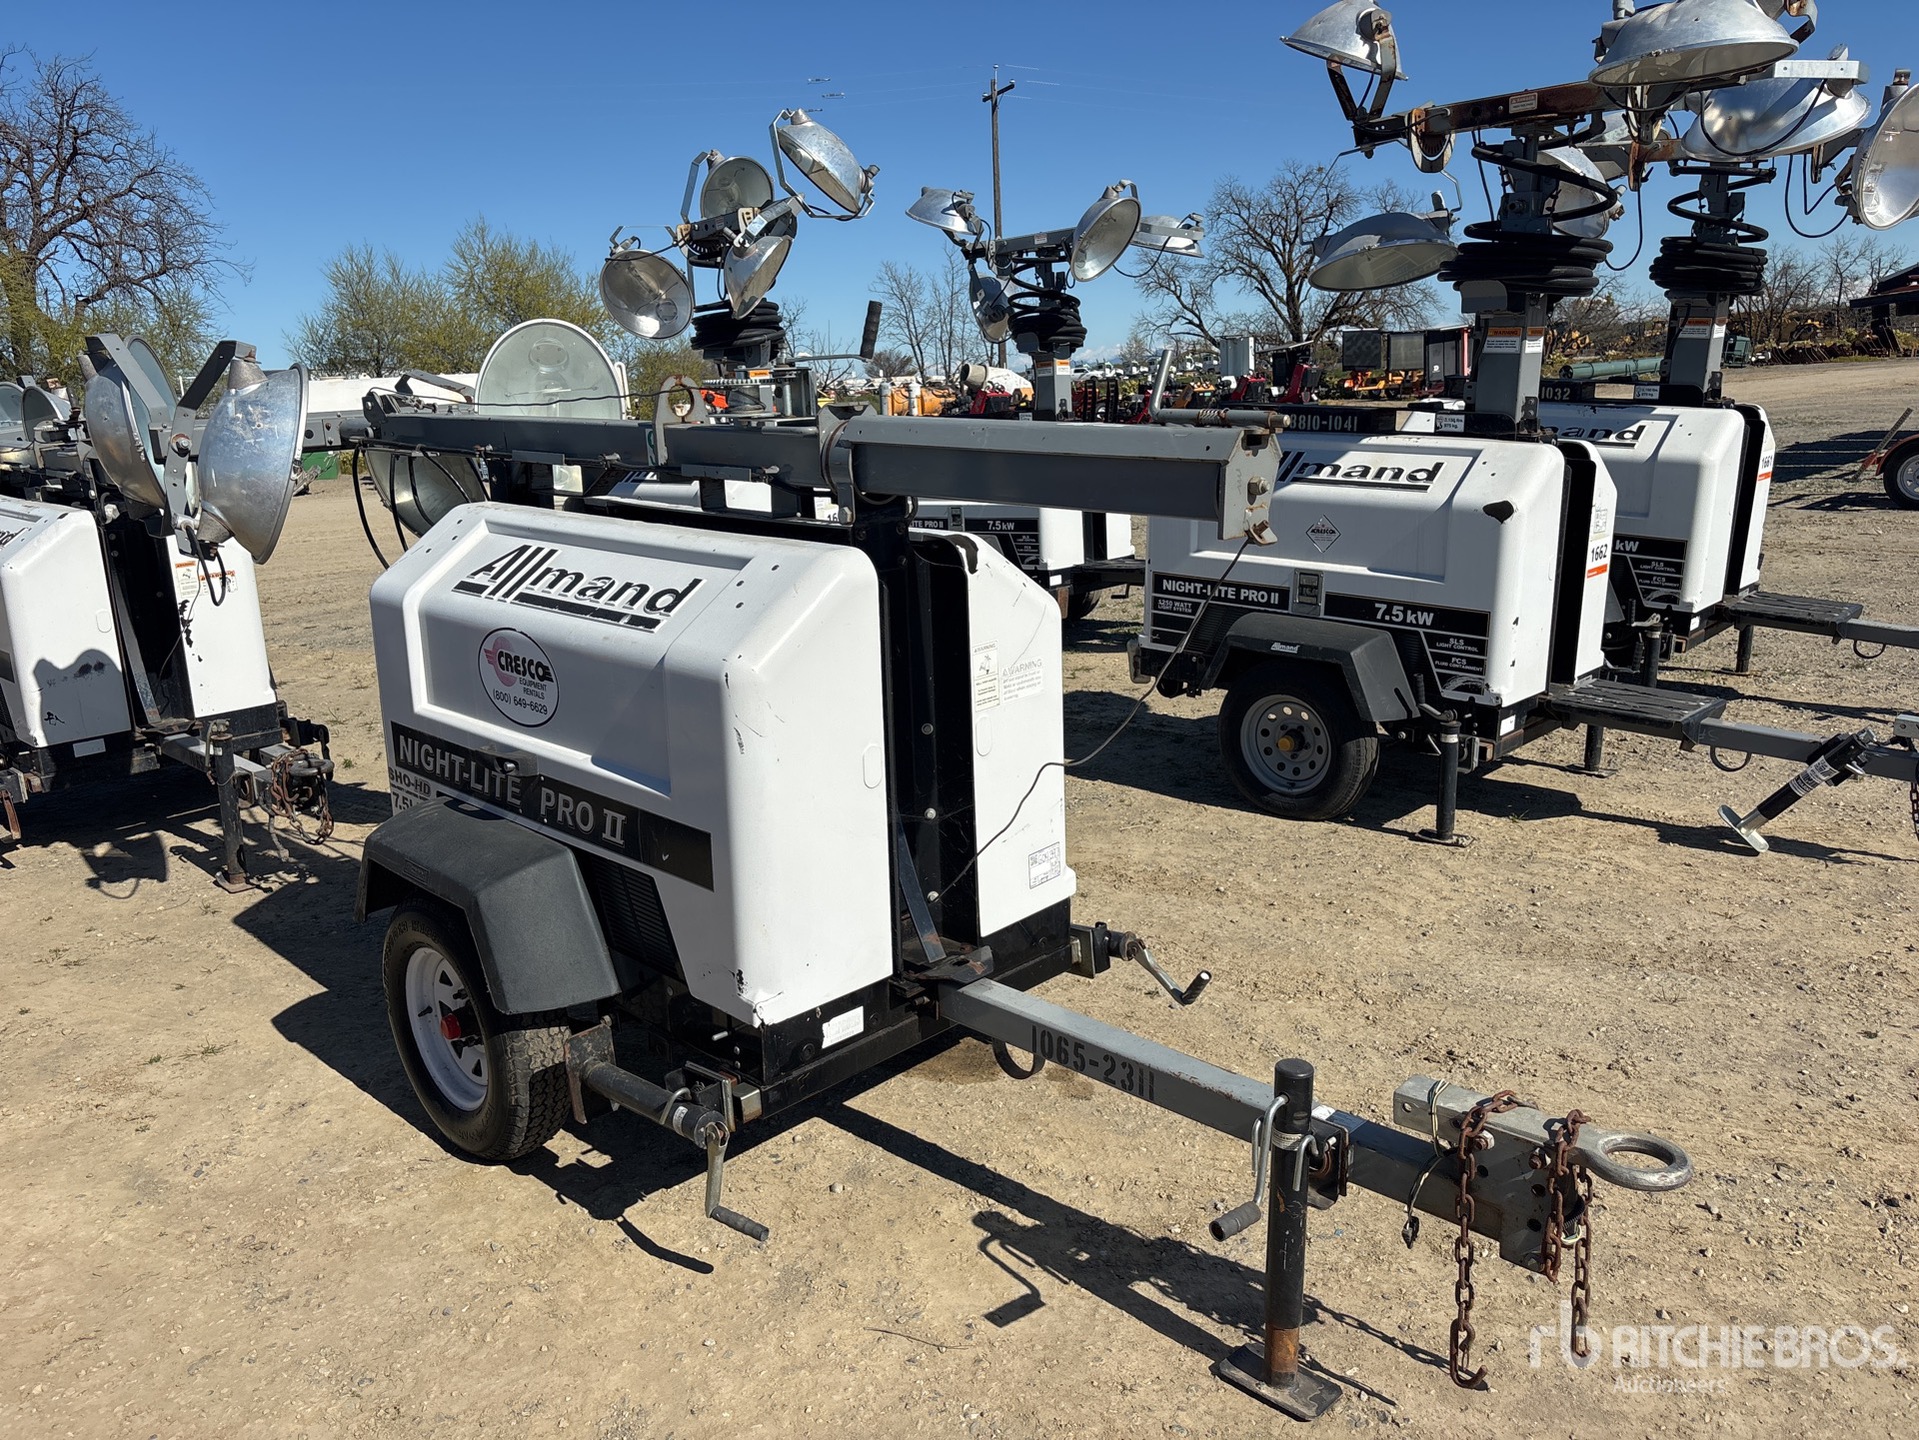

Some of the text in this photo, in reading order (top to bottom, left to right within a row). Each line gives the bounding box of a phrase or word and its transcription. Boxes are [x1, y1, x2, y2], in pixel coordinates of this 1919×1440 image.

[1278, 450, 1445, 484] llmand
[1591, 543, 1608, 562] 1662
[1615, 539, 1640, 552] kW
[467, 544, 704, 616] Allmand
[1173, 601, 1192, 609] WATT
[1240, 588, 1268, 604] PRO
[498, 650, 549, 682] CRESCO
[1451, 657, 1467, 665] FCS
[519, 677, 547, 691] EQUIPMENT
[523, 687, 545, 700] RENTALS
[493, 688, 548, 715] (800) 649-6629
[400, 734, 628, 848] NIGHT-LITE PRO II
[1031, 1025, 1154, 1101] 1065-2311
